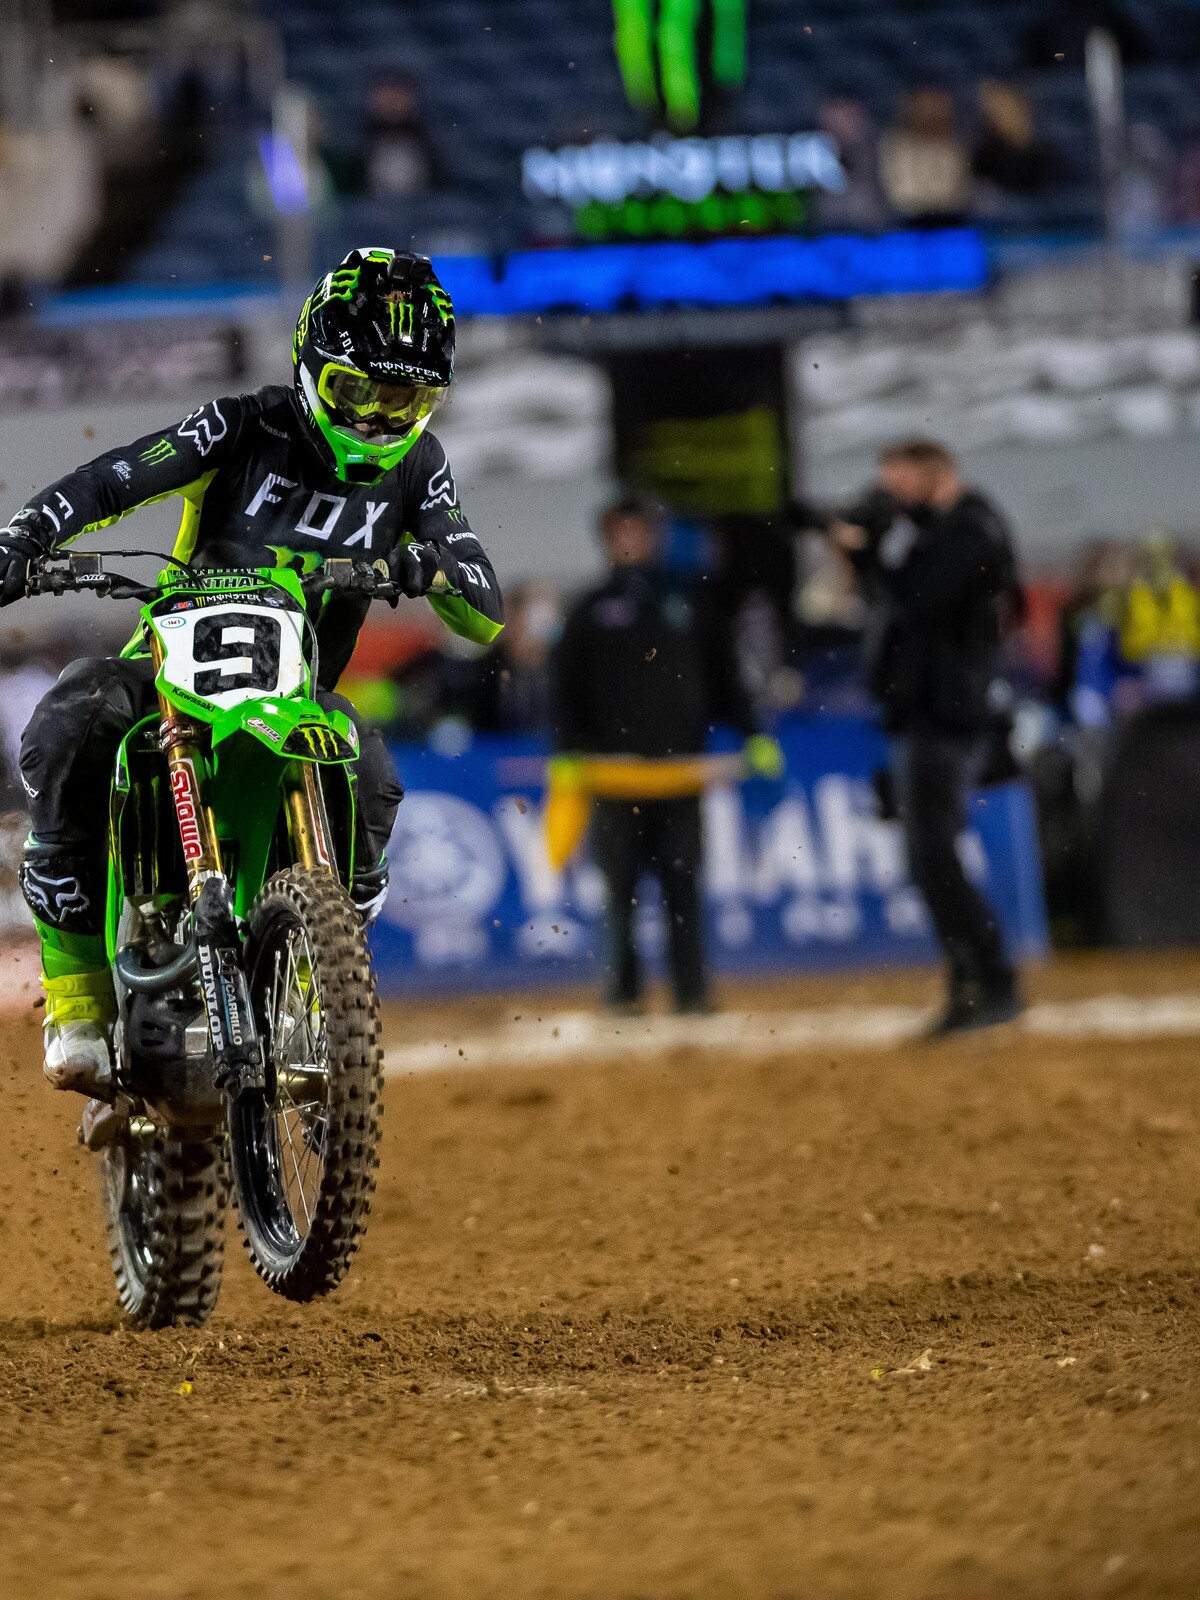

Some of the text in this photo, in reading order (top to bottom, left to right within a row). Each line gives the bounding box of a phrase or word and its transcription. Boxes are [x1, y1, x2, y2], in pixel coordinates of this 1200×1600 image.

[339, 330, 355, 355] FOX
[370, 361, 442, 380] MONSTER
[244, 472, 389, 549] FOX
[206, 592, 261, 602] MONSTER
[192, 612, 282, 697] 9
[171, 686, 216, 713] Kawasaki
[170, 769, 203, 862] SHOWA
[198, 944, 224, 1051] DUNLOP
[225, 984, 243, 1046] CARRILLO
